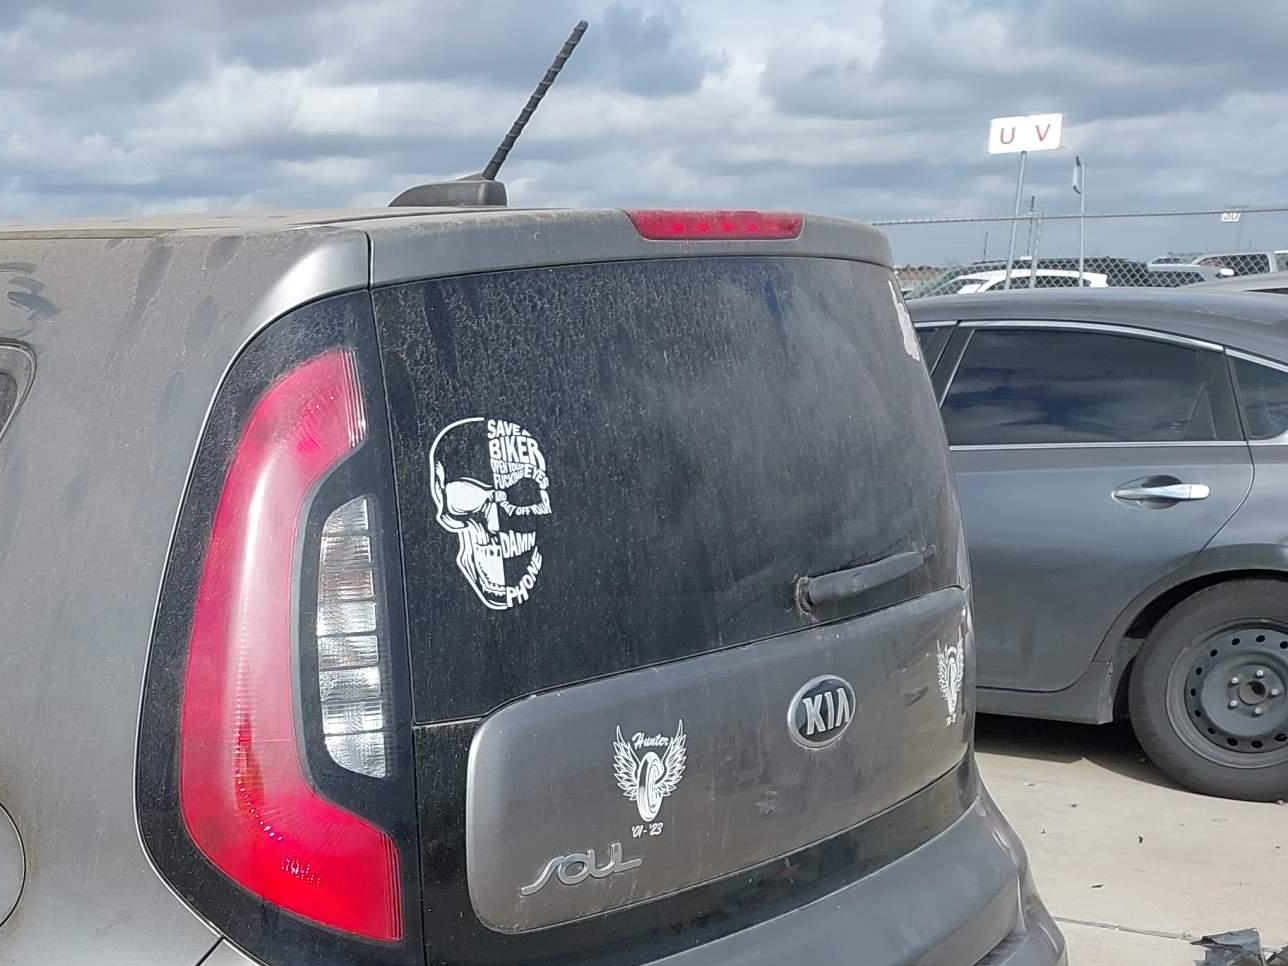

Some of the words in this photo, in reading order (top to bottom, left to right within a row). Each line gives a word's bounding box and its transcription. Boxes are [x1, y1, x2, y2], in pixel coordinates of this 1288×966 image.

[999, 126, 1016, 145] U
[1034, 123, 1051, 142] V
[487, 419, 521, 439] SAVE
[521, 429, 532, 437] A
[488, 435, 547, 472] BIKER
[493, 469, 524, 490] FUCKING
[524, 464, 549, 490] EYES
[515, 506, 531, 516] OFF
[529, 489, 552, 516] YOUR
[499, 529, 536, 558] DAMN
[506, 546, 542, 608] PHONE
[802, 687, 850, 735] KIA
[631, 732, 669, 750] Hunter
[519, 842, 644, 896] SOUL
